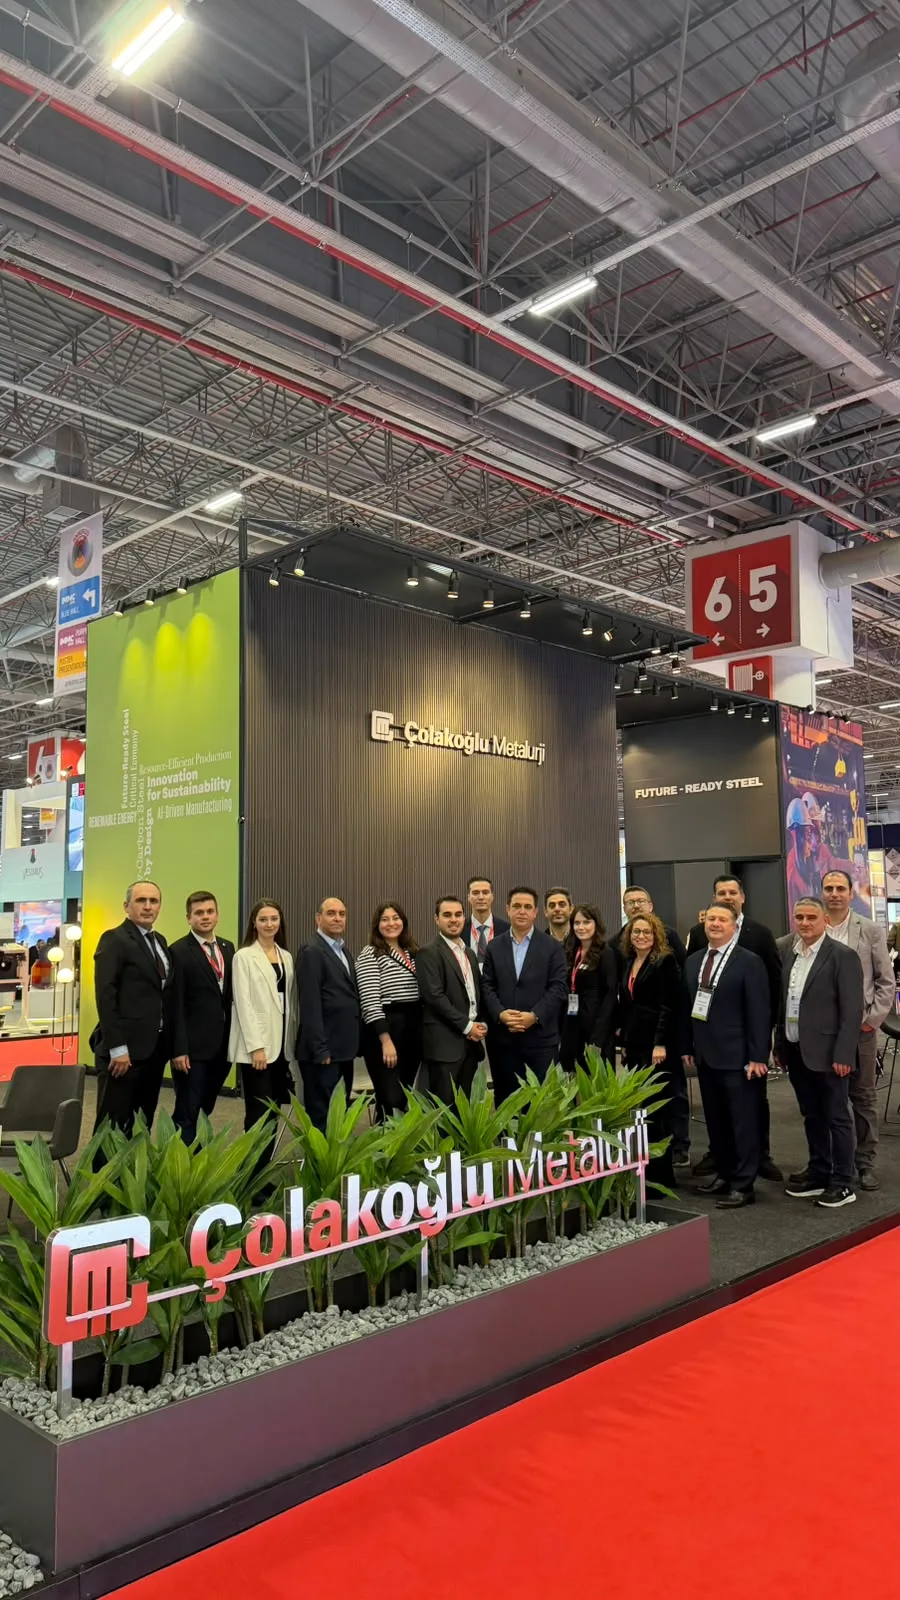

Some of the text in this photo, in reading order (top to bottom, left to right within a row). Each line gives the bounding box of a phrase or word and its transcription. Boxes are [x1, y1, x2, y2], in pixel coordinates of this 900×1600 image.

[704, 564, 777, 622] 6 5
[131, 729, 139, 771] Economy
[404, 721, 545, 765] Çolakoğlu Metalurji
[140, 749, 231, 774] Resource-Efficient Production
[147, 768, 198, 787] Innovation
[147, 777, 231, 801] for Sustainability
[726, 777, 763, 789] STEEL
[137, 778, 145, 813] Steel
[185, 797, 232, 816] Manufacturing
[88, 811, 137, 828] RENEWABLE ENERGY
[144, 808, 153, 875] by Design
[187, 1109, 649, 1303] Çolakoğlu Metalurji
